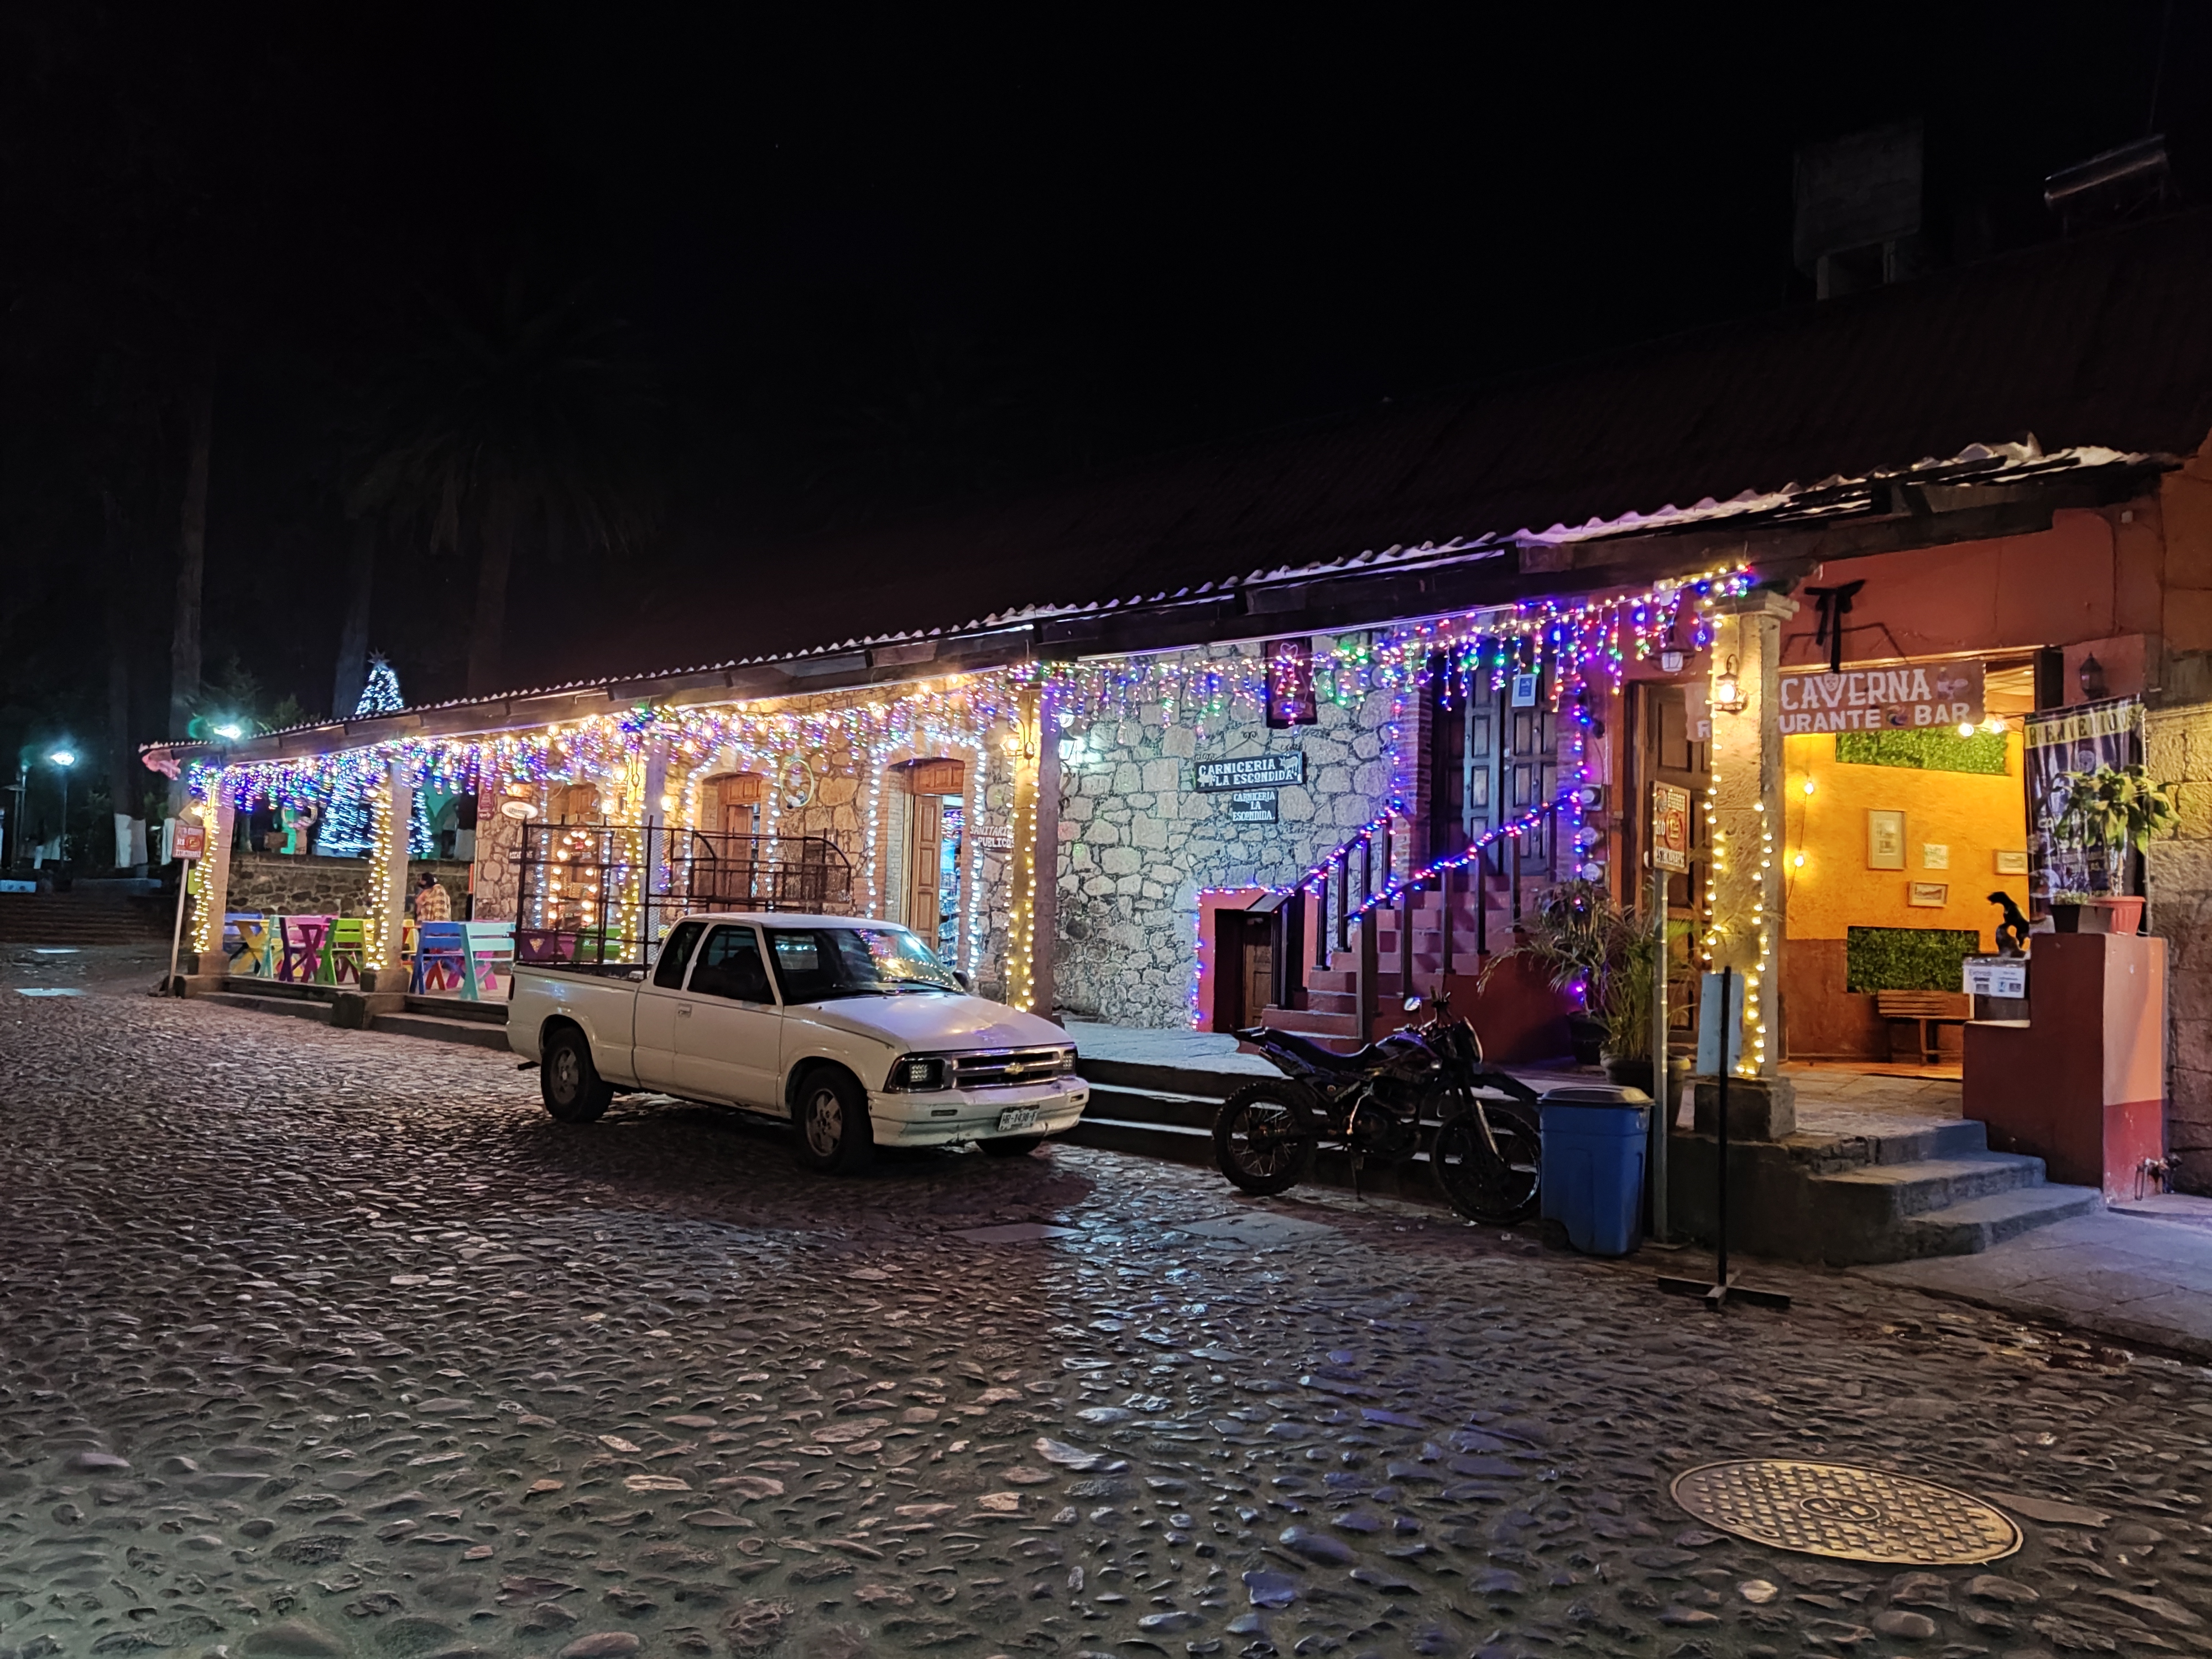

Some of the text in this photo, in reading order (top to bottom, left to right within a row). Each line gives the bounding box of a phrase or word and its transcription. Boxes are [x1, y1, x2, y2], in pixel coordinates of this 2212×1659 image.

[1781, 669, 1933, 710] CAVERNA
[1914, 703, 1970, 726] BAR
[1198, 758, 1276, 776] CARNICERIA
[1233, 791, 1275, 804] CARNICERIA
[1250, 801, 1261, 810] LA
